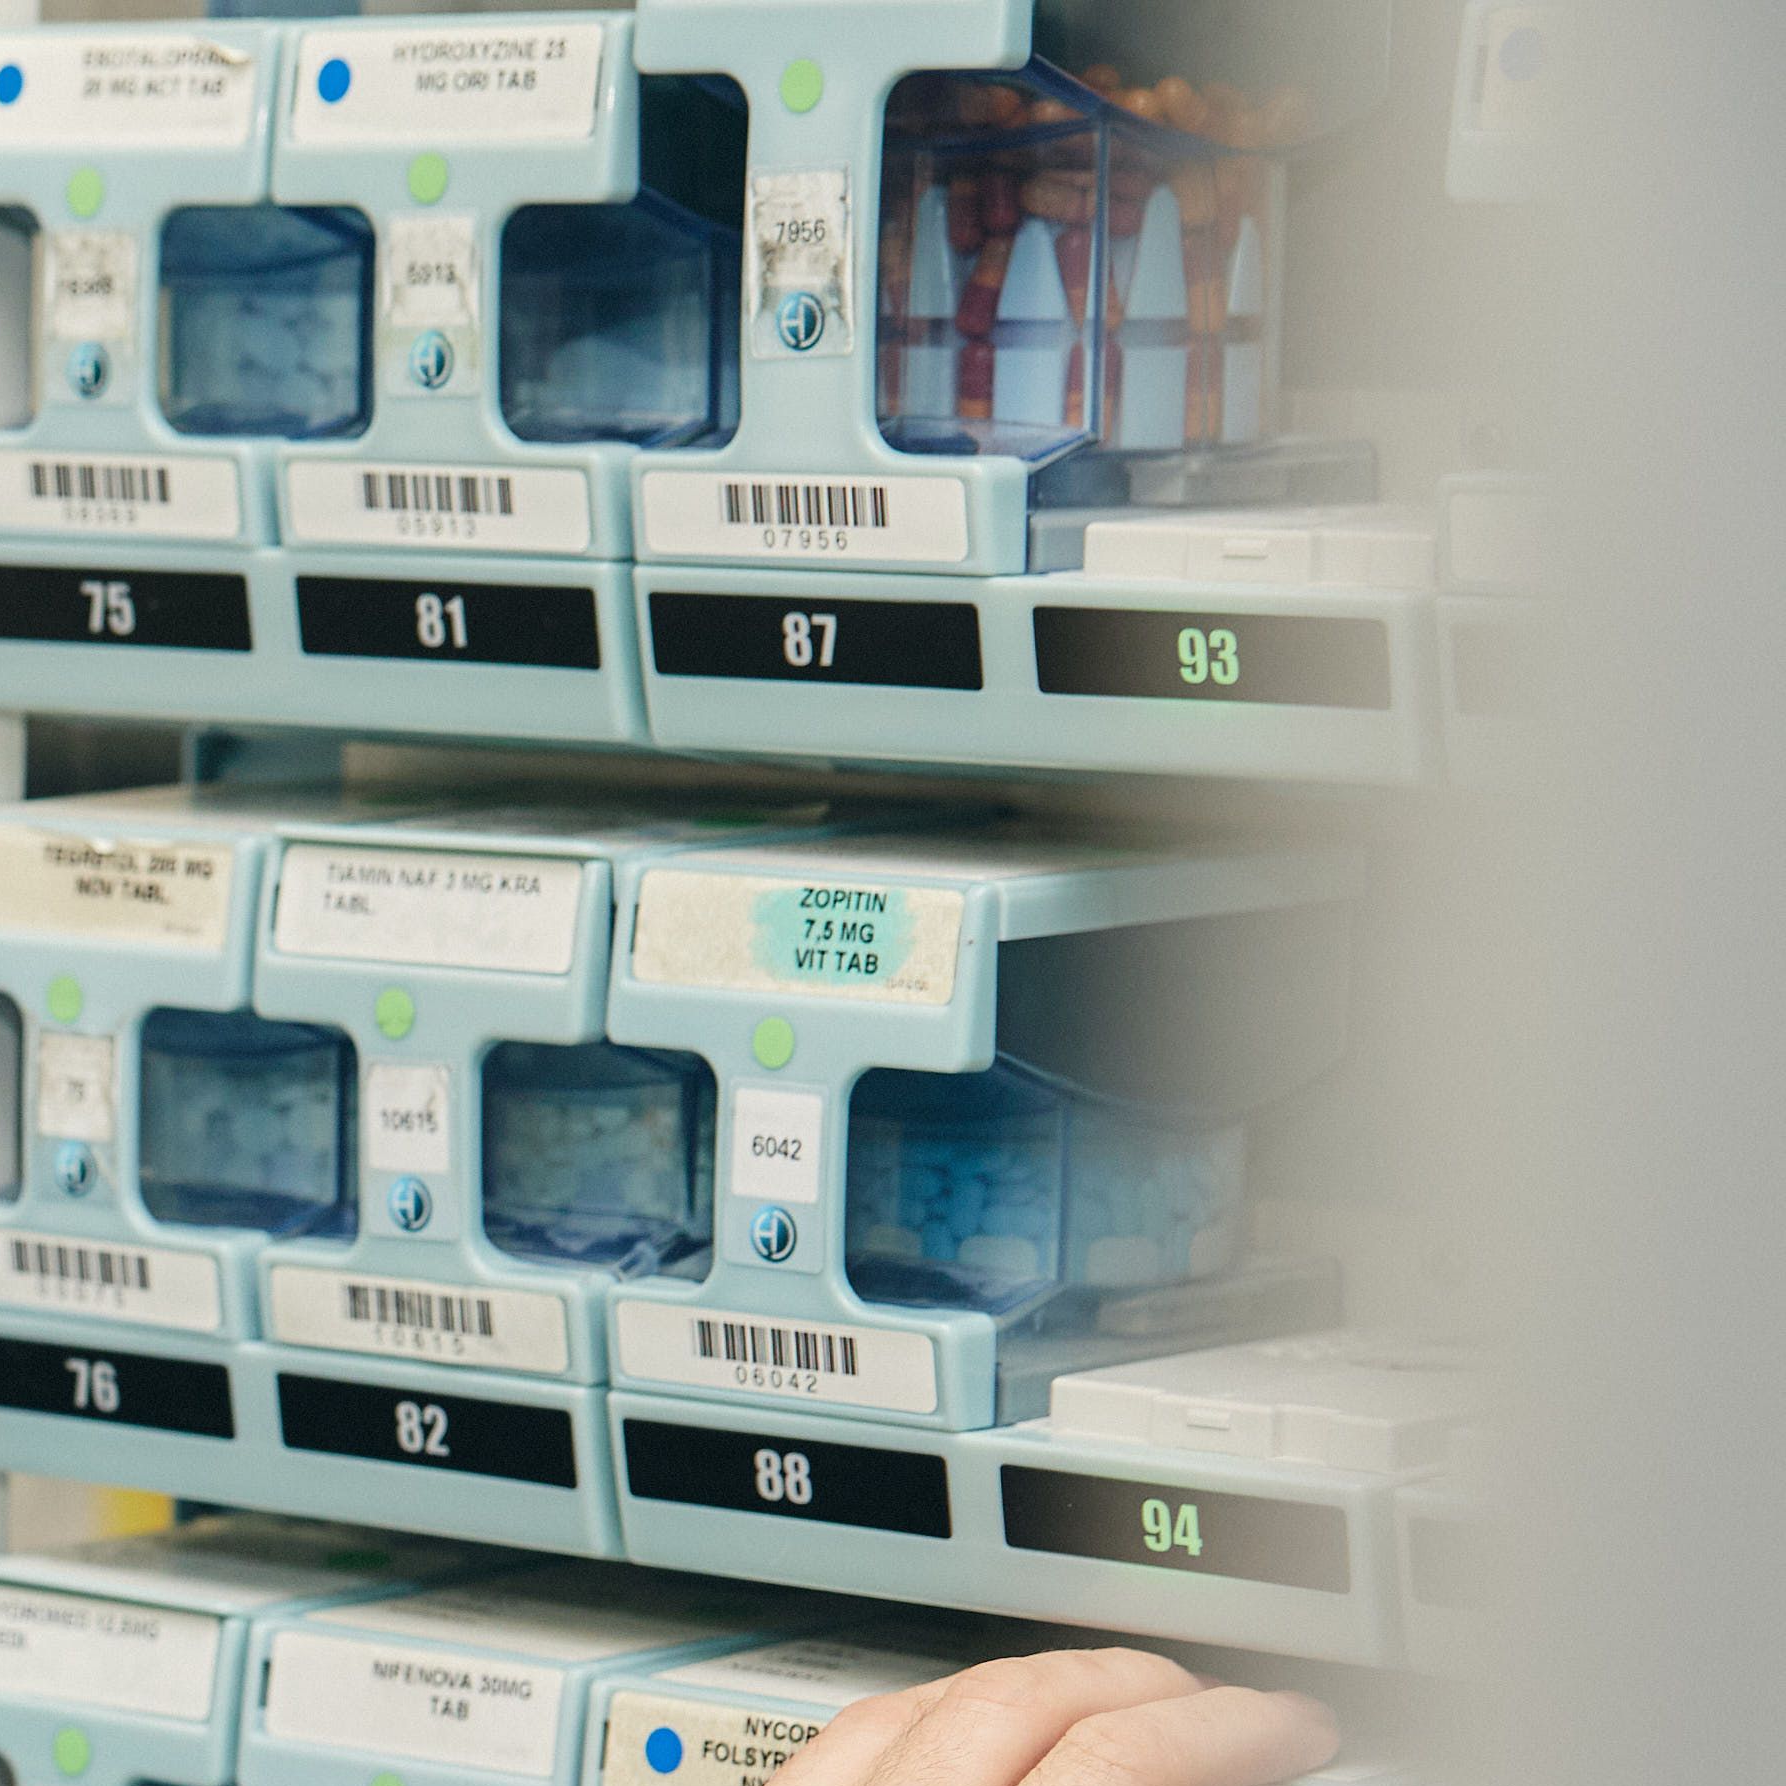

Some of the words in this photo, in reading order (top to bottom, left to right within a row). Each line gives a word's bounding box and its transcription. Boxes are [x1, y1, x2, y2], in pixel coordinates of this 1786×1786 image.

[496, 69, 537, 91] TAB
[776, 219, 826, 244] 7956
[762, 529, 848, 550] 07956
[80, 581, 135, 636] 75
[415, 593, 469, 649] 81
[782, 612, 837, 667] 87
[1177, 627, 1241, 686] 93
[462, 872, 493, 893] MG
[799, 887, 888, 913] ZOPITIN
[804, 918, 834, 942] 7,5
[839, 921, 875, 944] MG
[795, 948, 829, 971] VIT
[835, 951, 879, 975] TAB
[752, 1134, 803, 1162] 6042
[66, 1356, 120, 1412] 76
[735, 1364, 818, 1394] 06042
[395, 1401, 449, 1457] 82
[753, 1448, 814, 1506] 88
[1141, 1499, 1204, 1557] 94
[373, 1660, 473, 1690] NIFENOVA
[430, 1695, 471, 1721] TAB
[745, 1716, 820, 1745] NYCOP
[701, 1740, 794, 1768] FOLSYR
